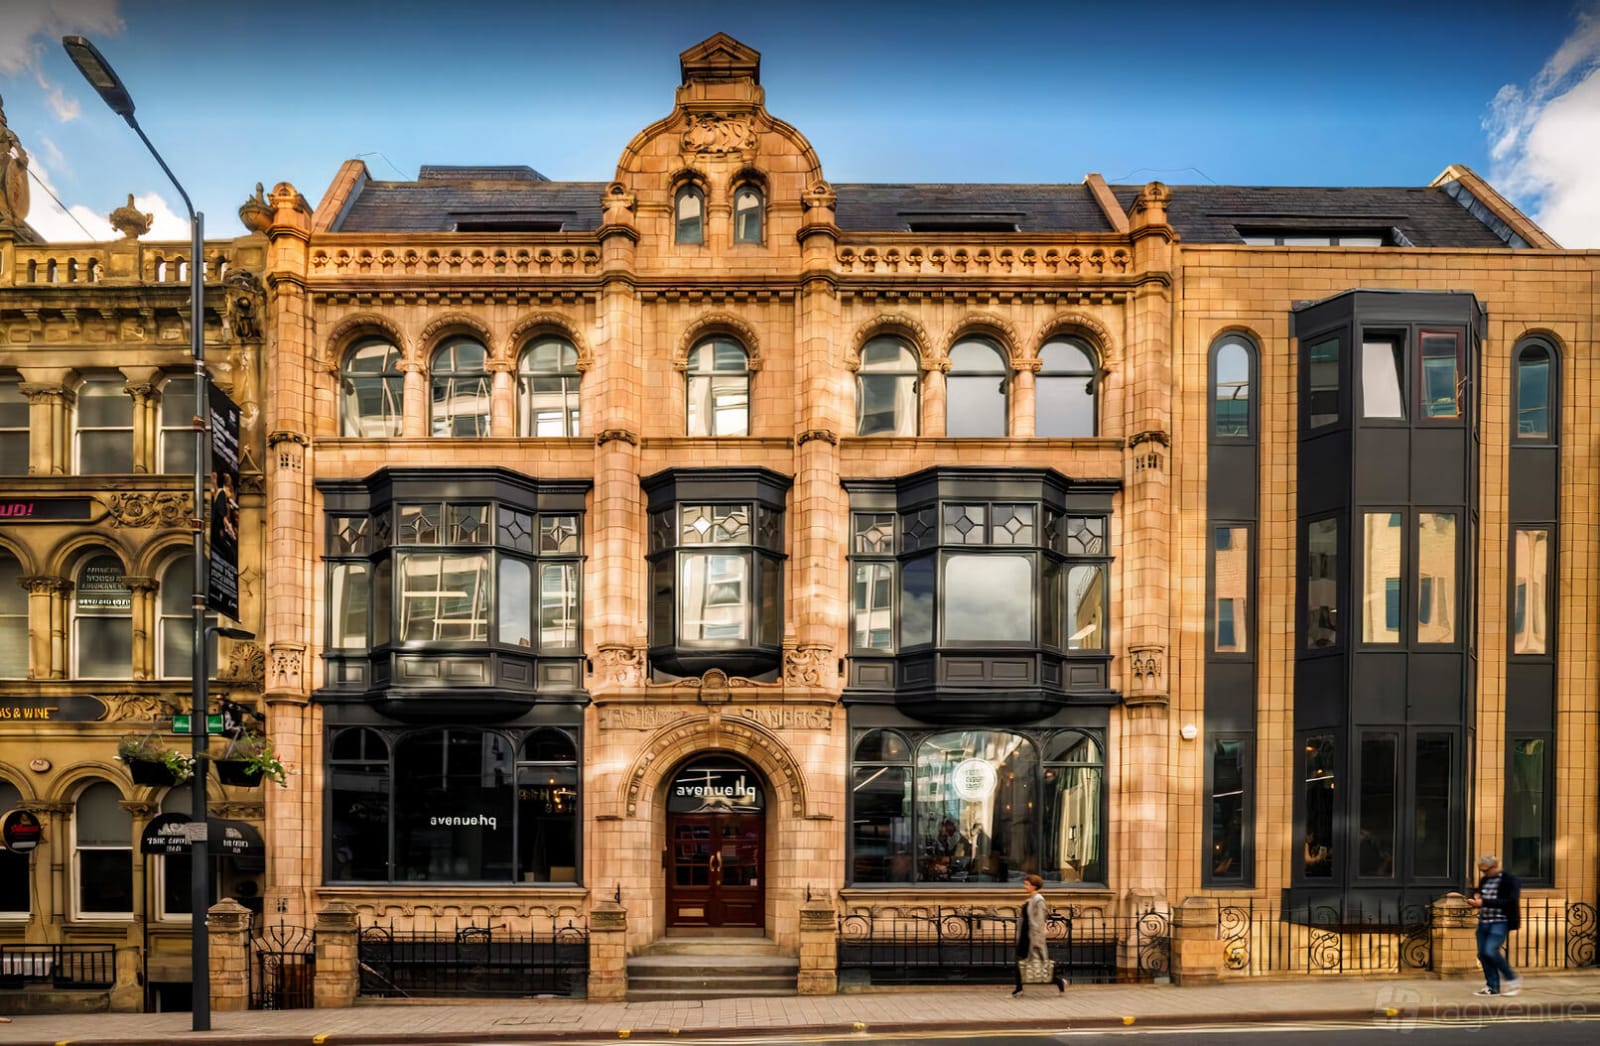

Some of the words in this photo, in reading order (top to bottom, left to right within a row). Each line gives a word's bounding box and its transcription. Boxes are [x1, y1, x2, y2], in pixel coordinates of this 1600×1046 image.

[24, 707, 50, 719] WINE
[676, 780, 756, 802] avenuehq
[430, 814, 497, 830] avenuehq
